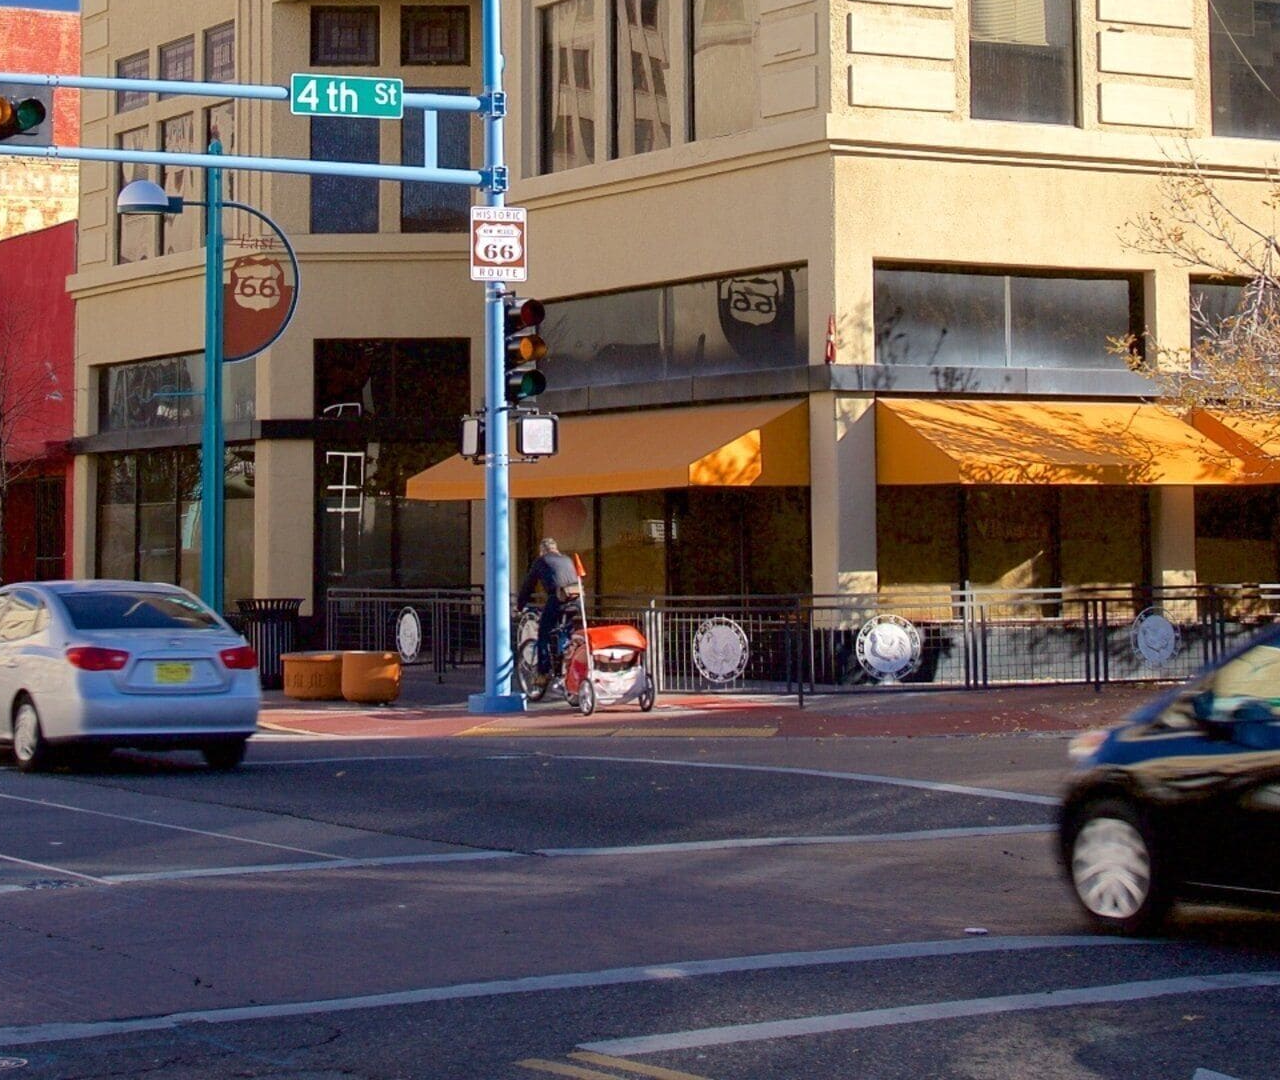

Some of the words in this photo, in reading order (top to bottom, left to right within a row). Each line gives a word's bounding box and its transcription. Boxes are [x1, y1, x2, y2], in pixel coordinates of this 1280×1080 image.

[297, 80, 358, 112] 4th
[374, 82, 397, 106] St
[475, 210, 521, 220] HISTORIC
[239, 233, 274, 250] East
[484, 243, 514, 260] 66
[479, 268, 519, 277] ROUTE
[239, 275, 275, 298] 66
